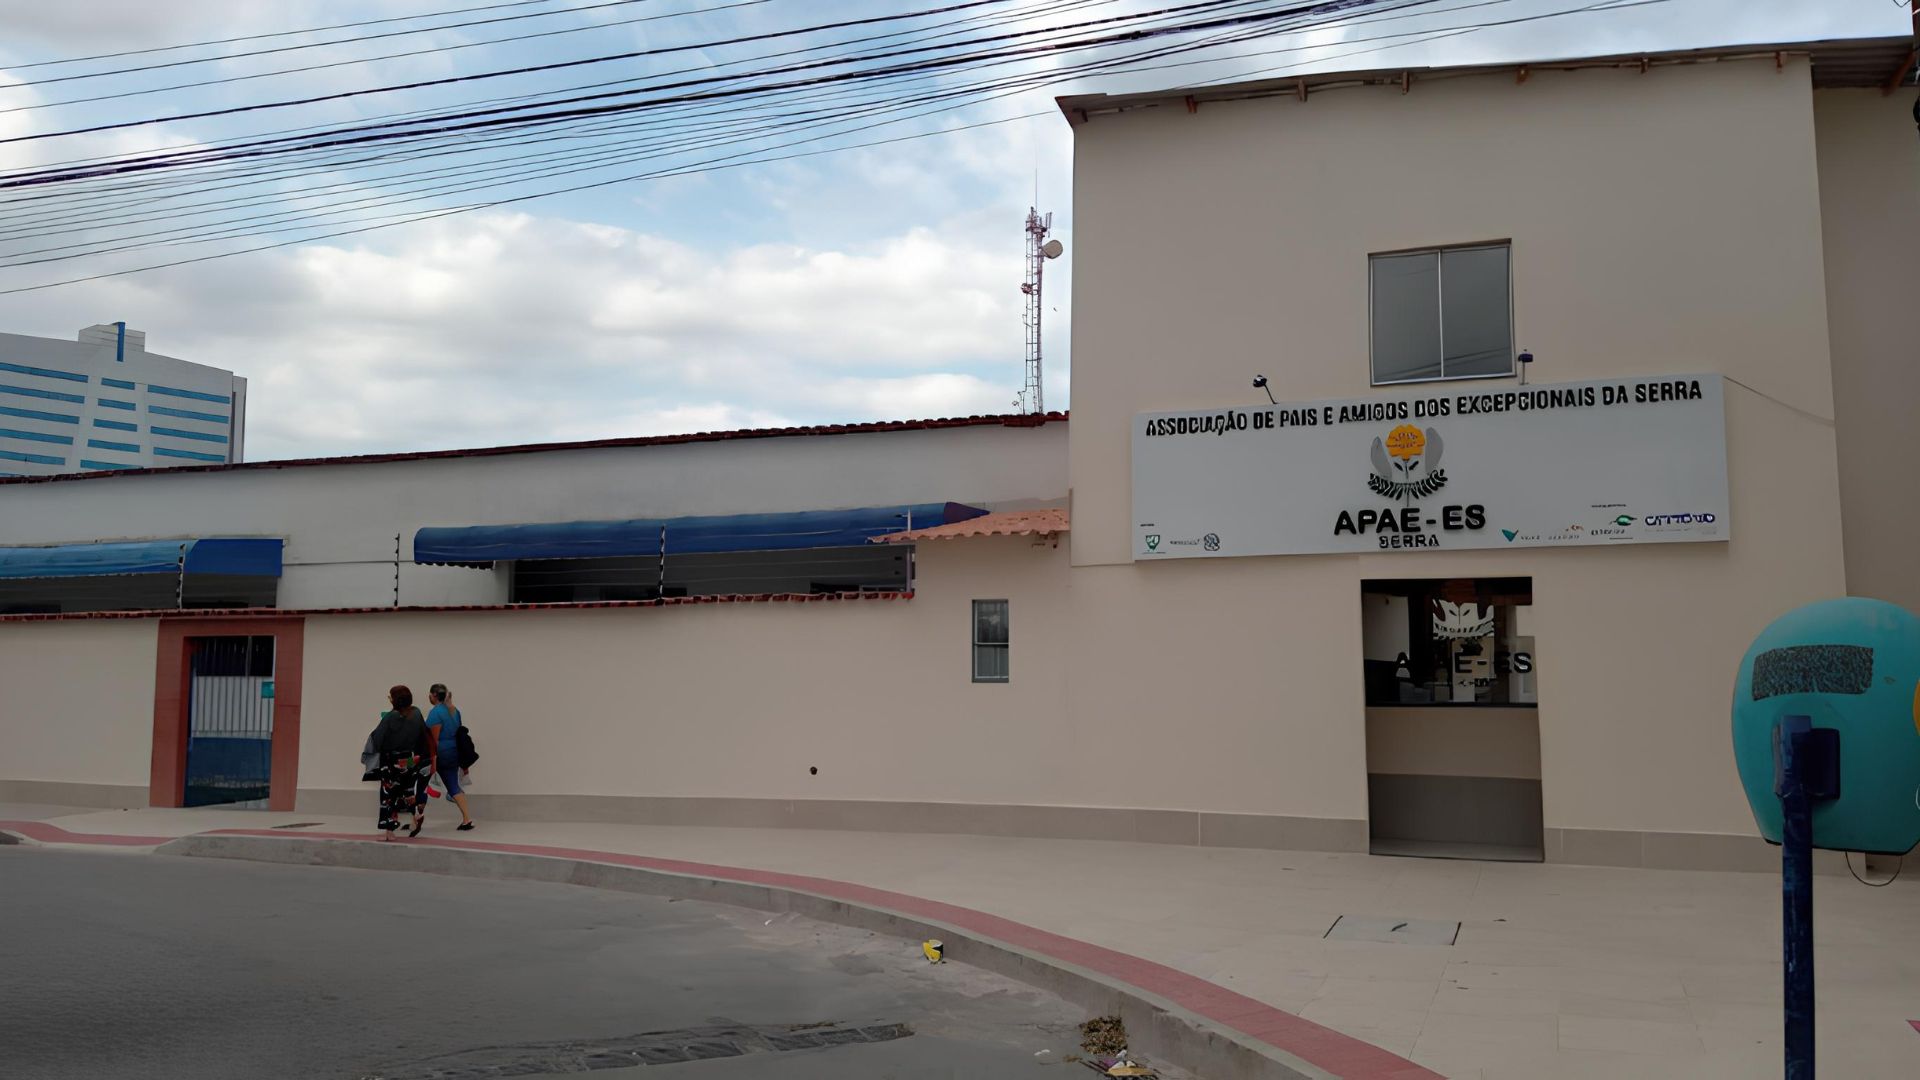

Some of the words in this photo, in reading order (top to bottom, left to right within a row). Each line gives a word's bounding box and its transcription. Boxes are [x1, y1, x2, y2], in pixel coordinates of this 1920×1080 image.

[1253, 410, 1275, 430] DE
[1279, 408, 1318, 428] PAIS
[1323, 406, 1333, 426] E
[1338, 401, 1409, 424] AMIGOS
[1414, 398, 1451, 418] DOS
[1456, 386, 1596, 415] EXCEPCIONAIS
[1601, 385, 1629, 406] DA
[1635, 380, 1702, 404] SERRA
[1333, 504, 1486, 536] APAE-ES
[1378, 534, 1440, 549] SERRA
